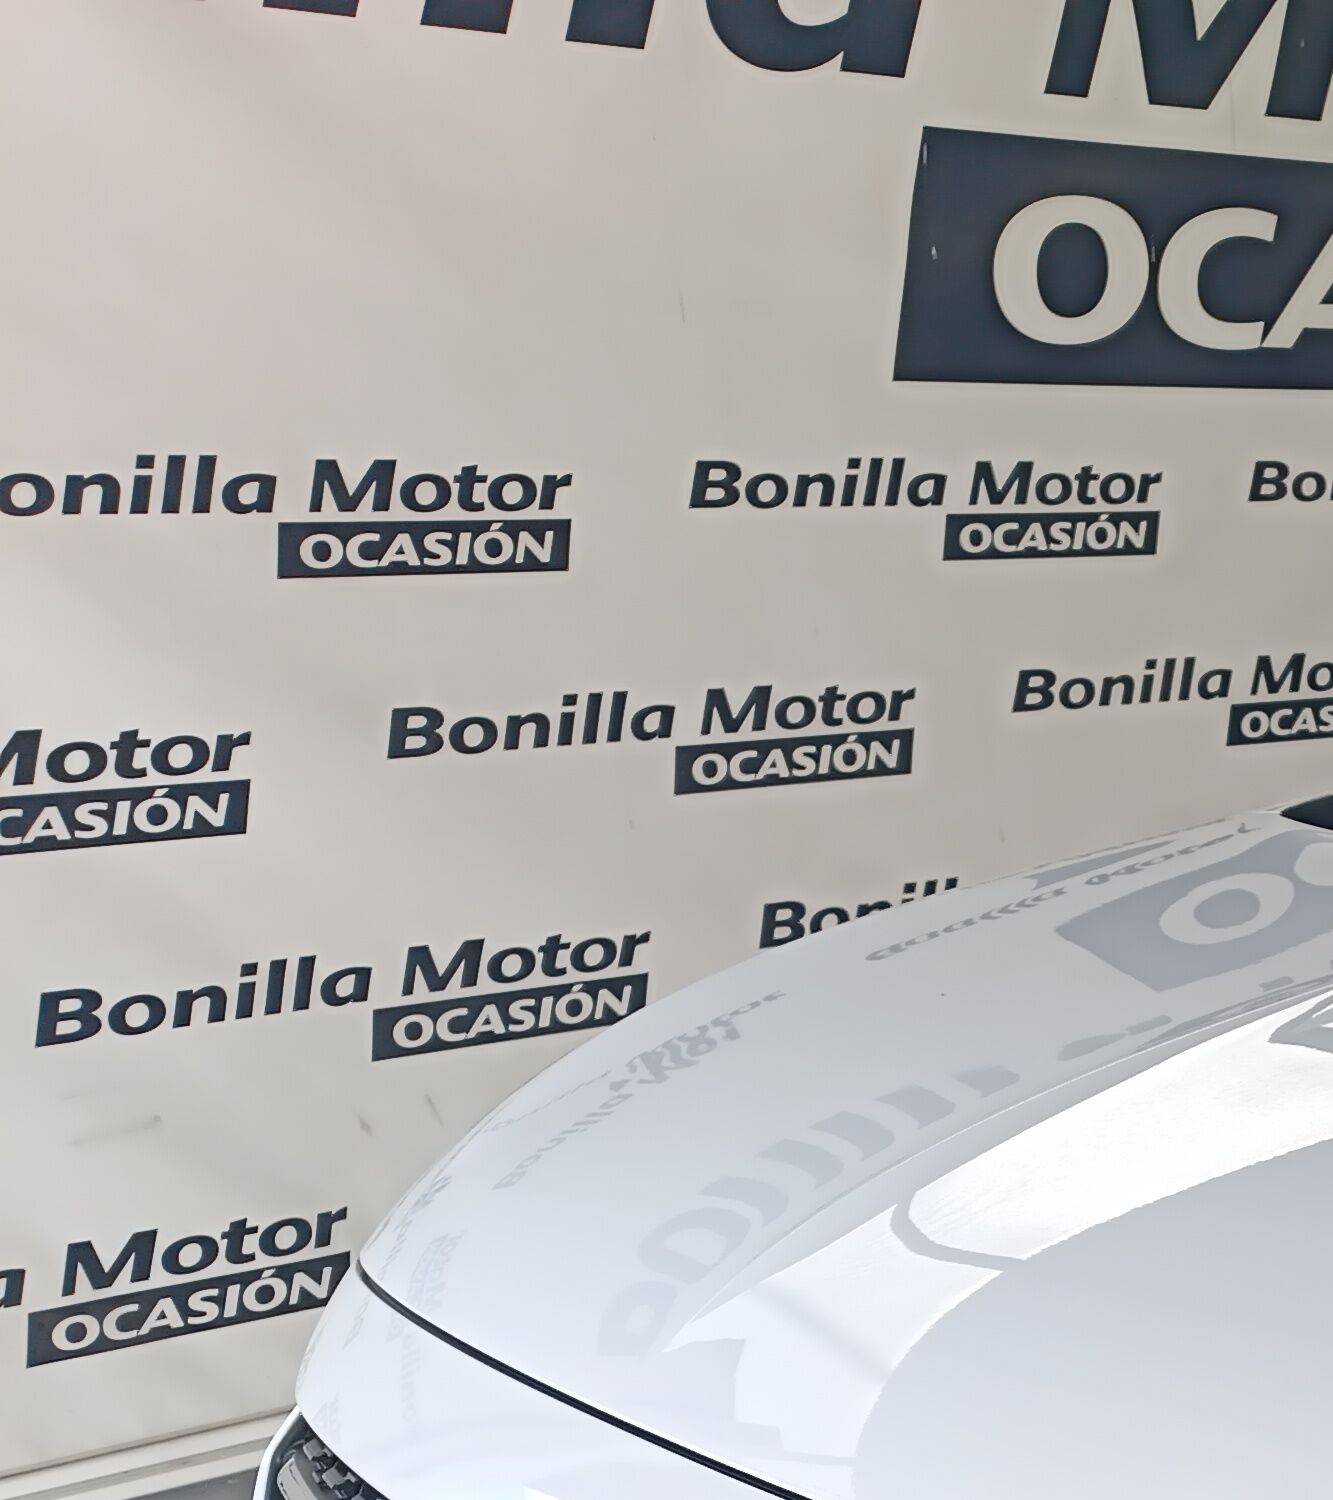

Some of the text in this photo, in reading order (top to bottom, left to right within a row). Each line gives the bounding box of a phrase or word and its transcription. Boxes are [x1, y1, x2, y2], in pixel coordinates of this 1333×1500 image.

[309, 459, 573, 514] Motor
[689, 457, 1162, 509] Bonilla Motor
[299, 523, 555, 569] OCASIÓN
[959, 514, 1148, 553] OCASIÓN
[1012, 657, 1233, 713] Bonilla
[387, 684, 916, 759] Bonilla Motor
[692, 736, 900, 785] OCASIÓN
[35, 931, 651, 1047] Bonilla Motor
[392, 984, 632, 1049] OCASIÓN
[61, 1206, 348, 1297] Motor
[52, 1267, 332, 1350] OCASIÓN
